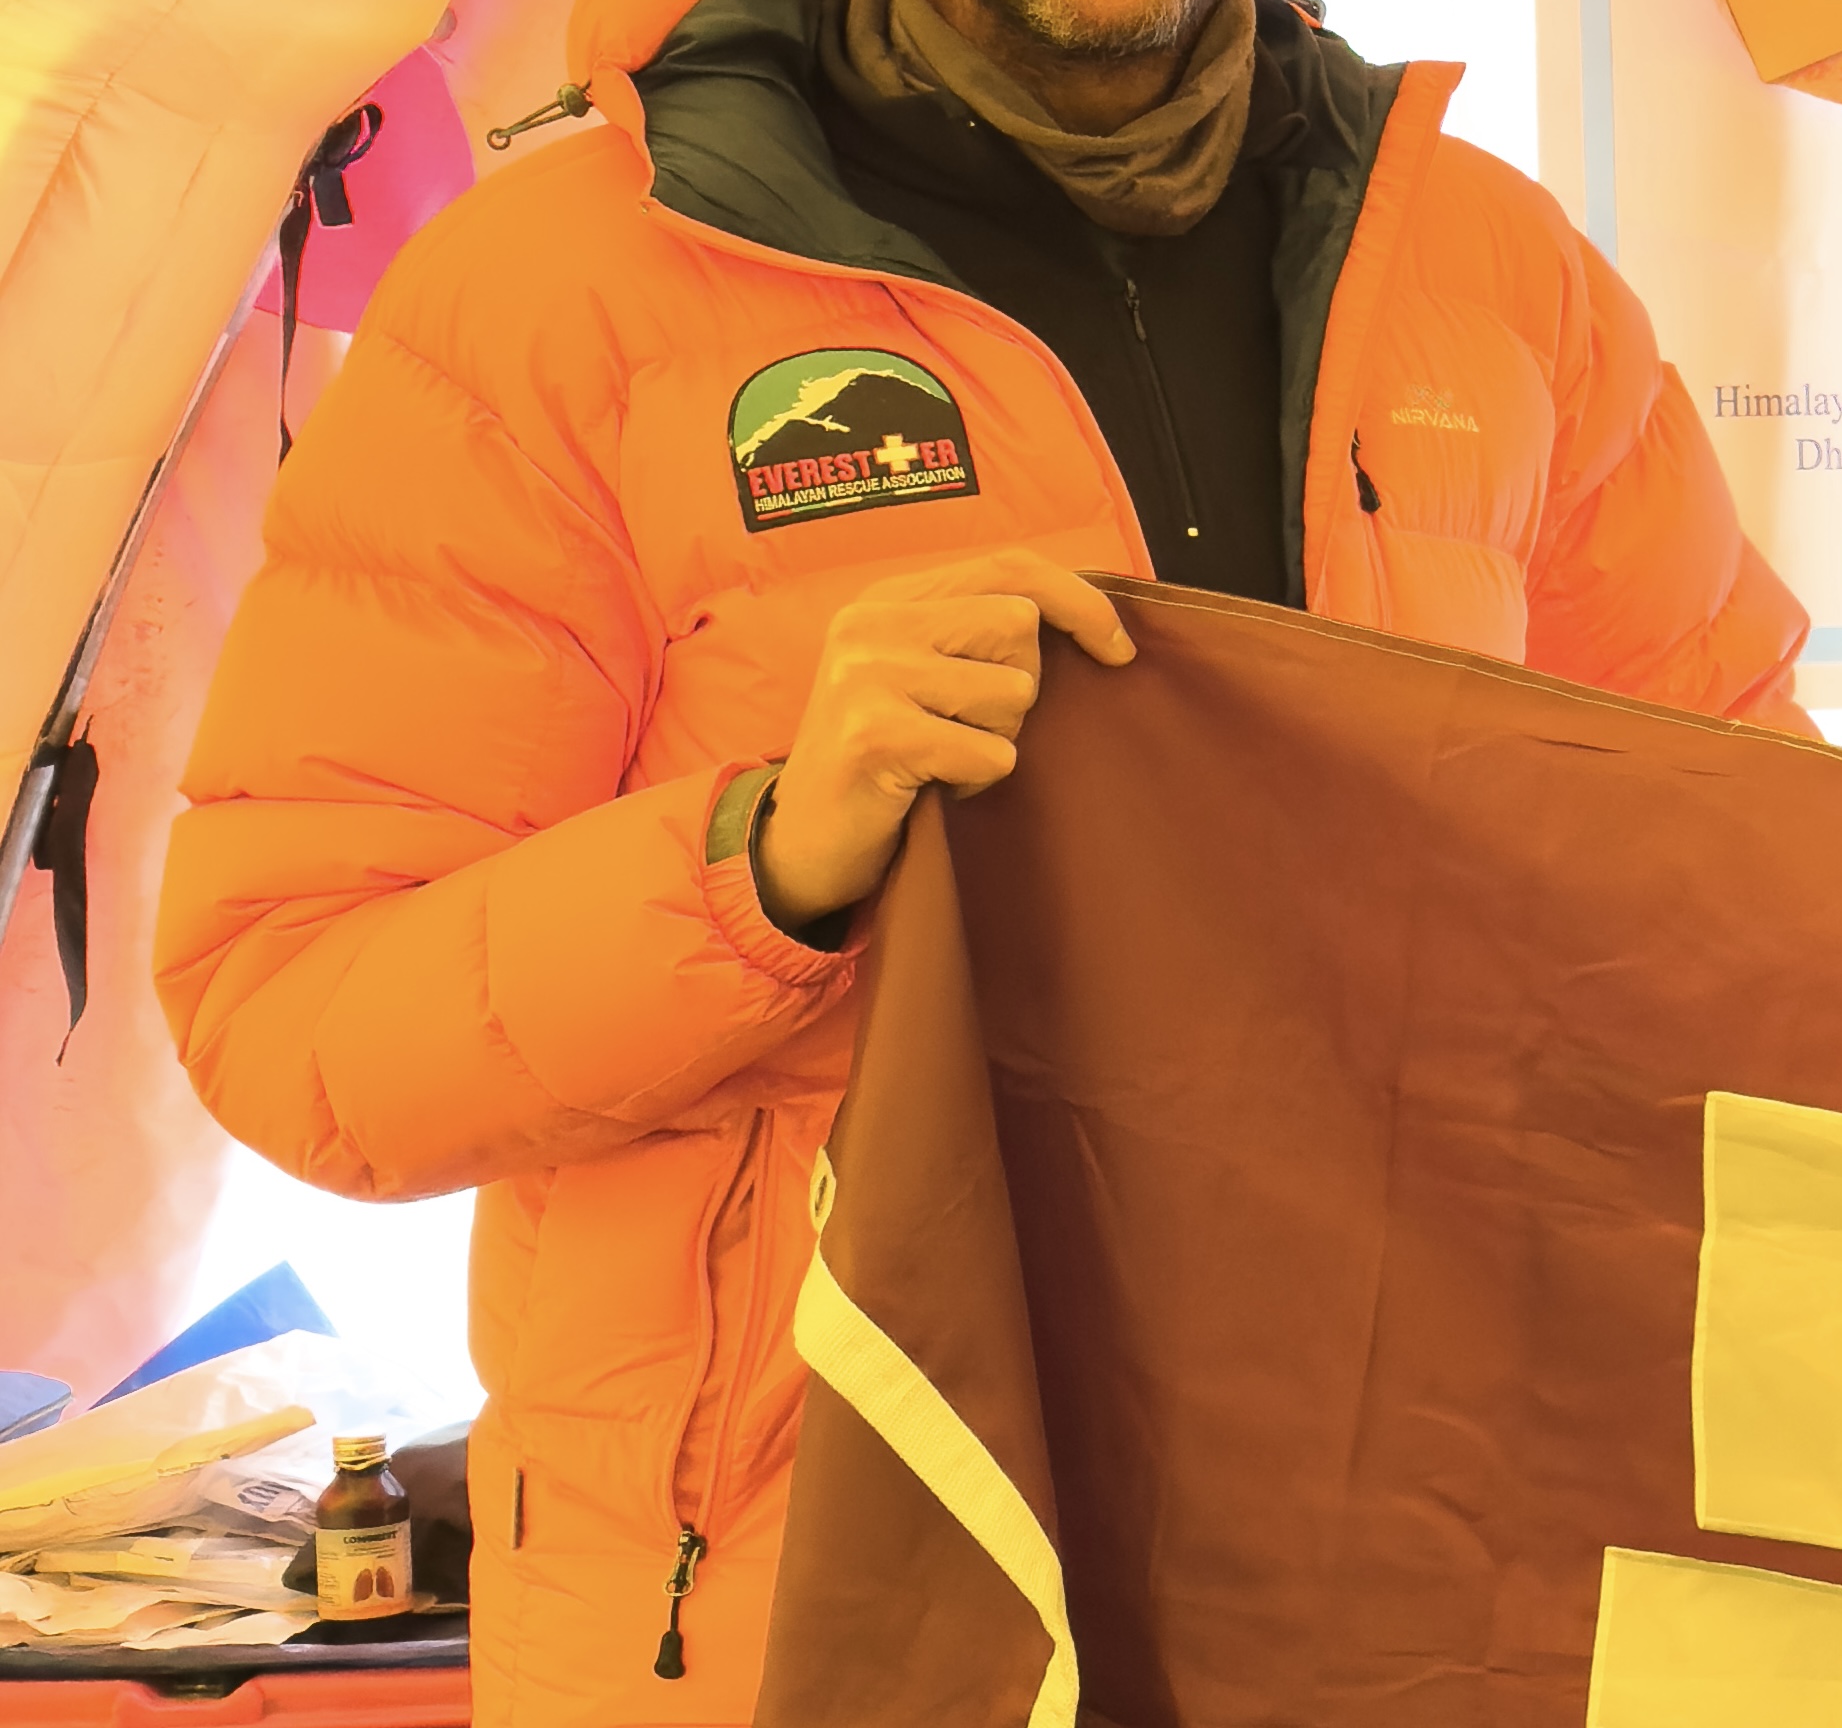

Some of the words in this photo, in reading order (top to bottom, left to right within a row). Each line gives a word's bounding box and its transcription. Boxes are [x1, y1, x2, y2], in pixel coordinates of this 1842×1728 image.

[1391, 407, 1481, 433] NIRVANA
[747, 450, 874, 498] EVEREST
[918, 438, 960, 470] ER
[754, 485, 828, 513] HIMALAYAN
[828, 477, 881, 499] RESCUE
[881, 466, 966, 491] ASSOCIATION
